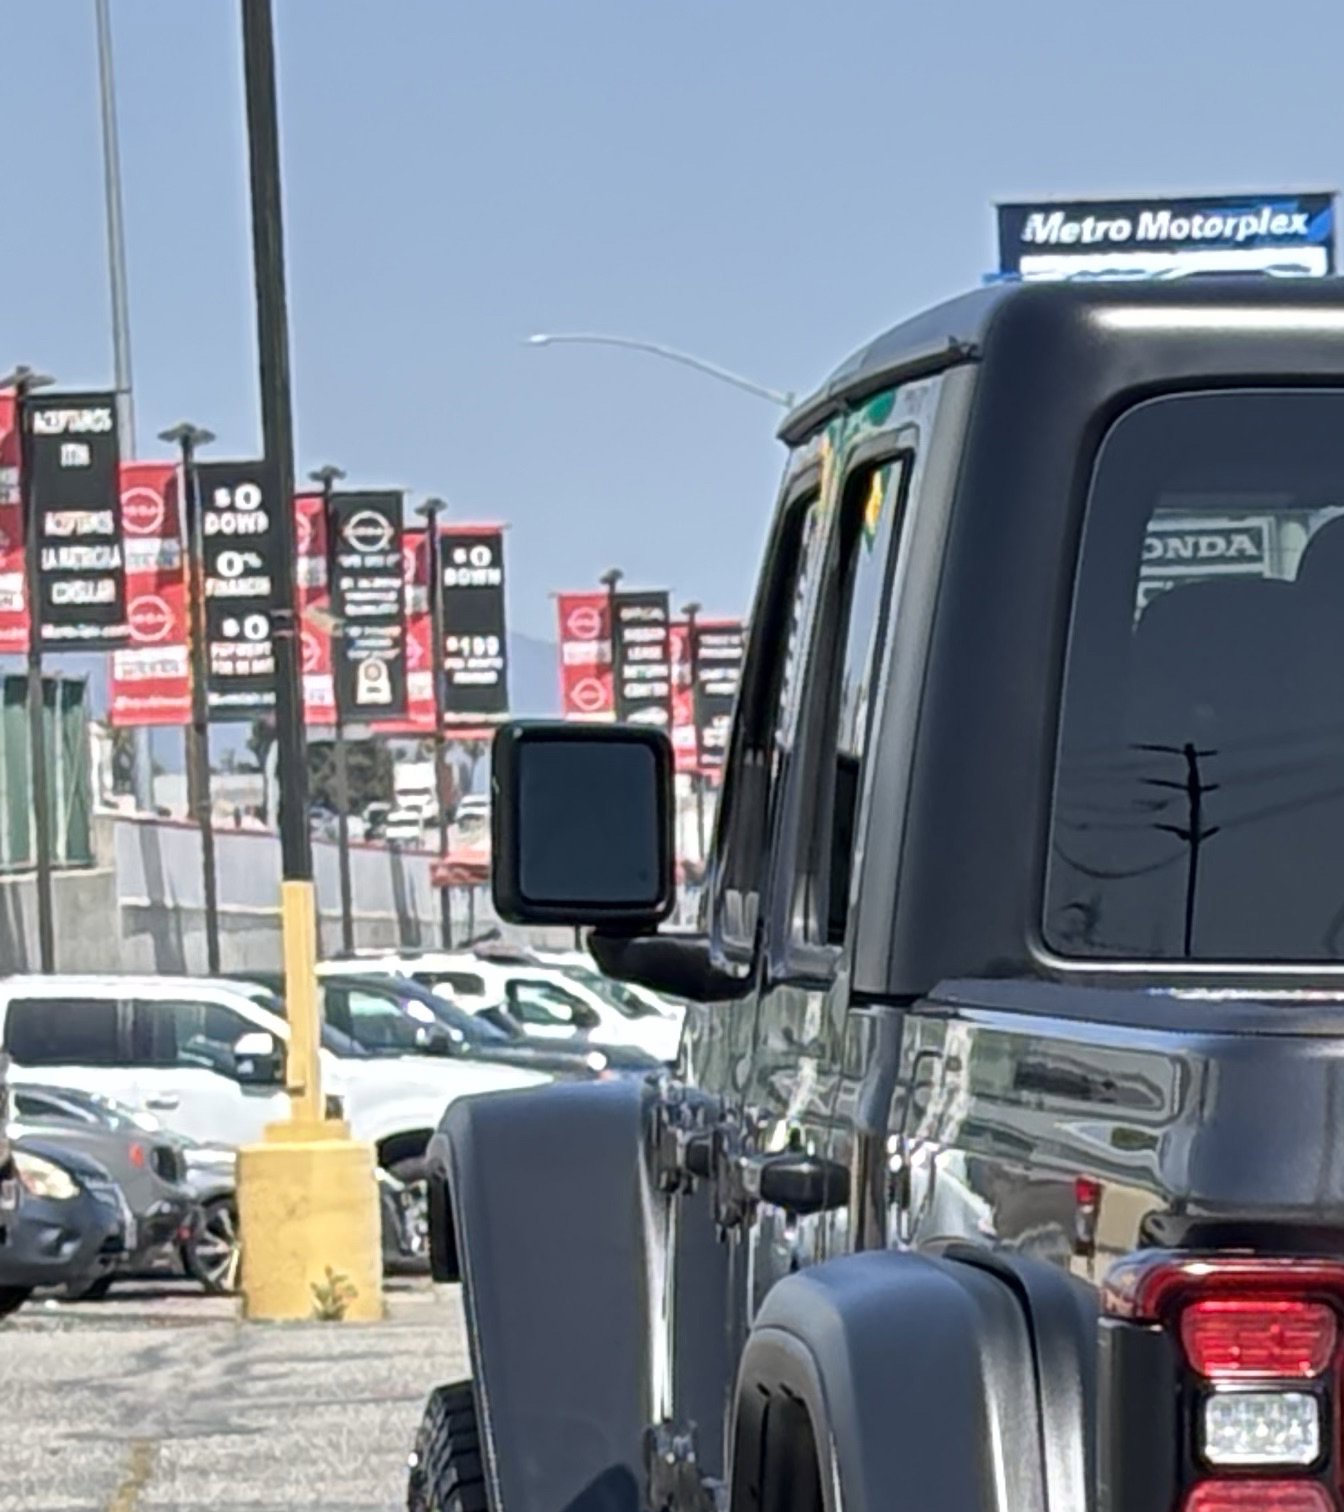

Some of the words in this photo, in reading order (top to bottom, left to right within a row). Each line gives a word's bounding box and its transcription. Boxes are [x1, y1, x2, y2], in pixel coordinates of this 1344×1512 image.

[1022, 209, 1133, 244] Metro
[1135, 206, 1309, 242] Motorplex
[1142, 533, 1260, 561] ONDA
